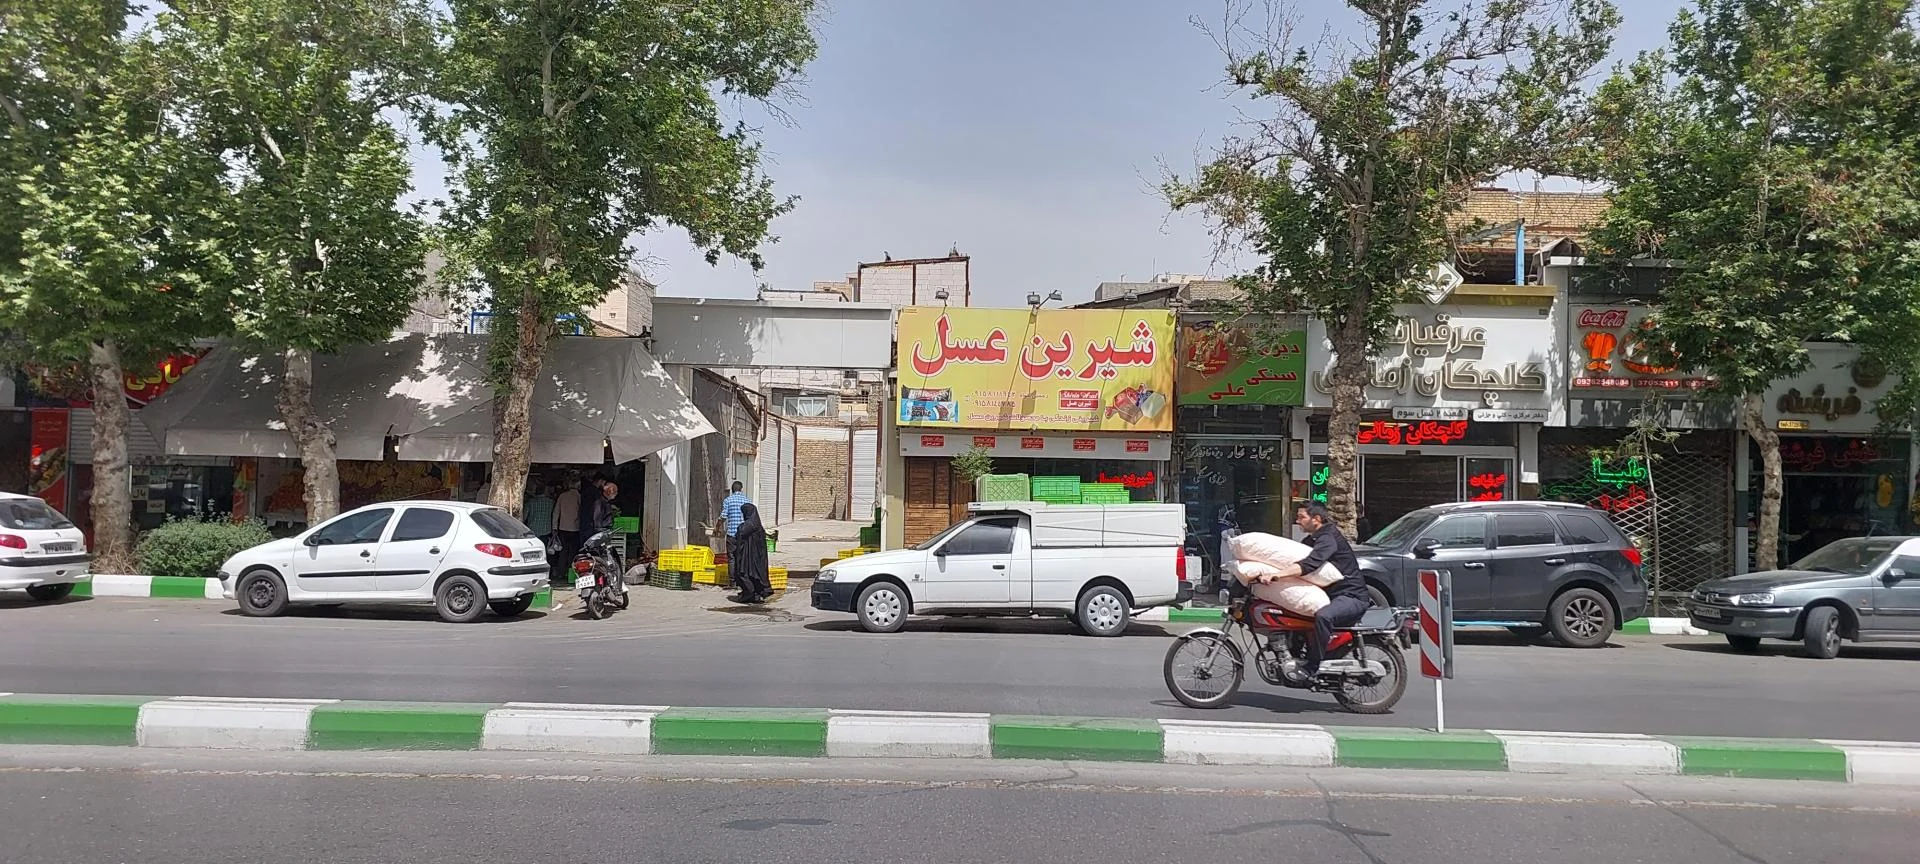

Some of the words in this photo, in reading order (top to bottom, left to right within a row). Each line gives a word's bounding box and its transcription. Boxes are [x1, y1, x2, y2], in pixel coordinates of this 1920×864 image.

[911, 313, 1008, 377] عسل
[1020, 319, 1157, 382] شیرین
[1208, 382, 1246, 401] علی
